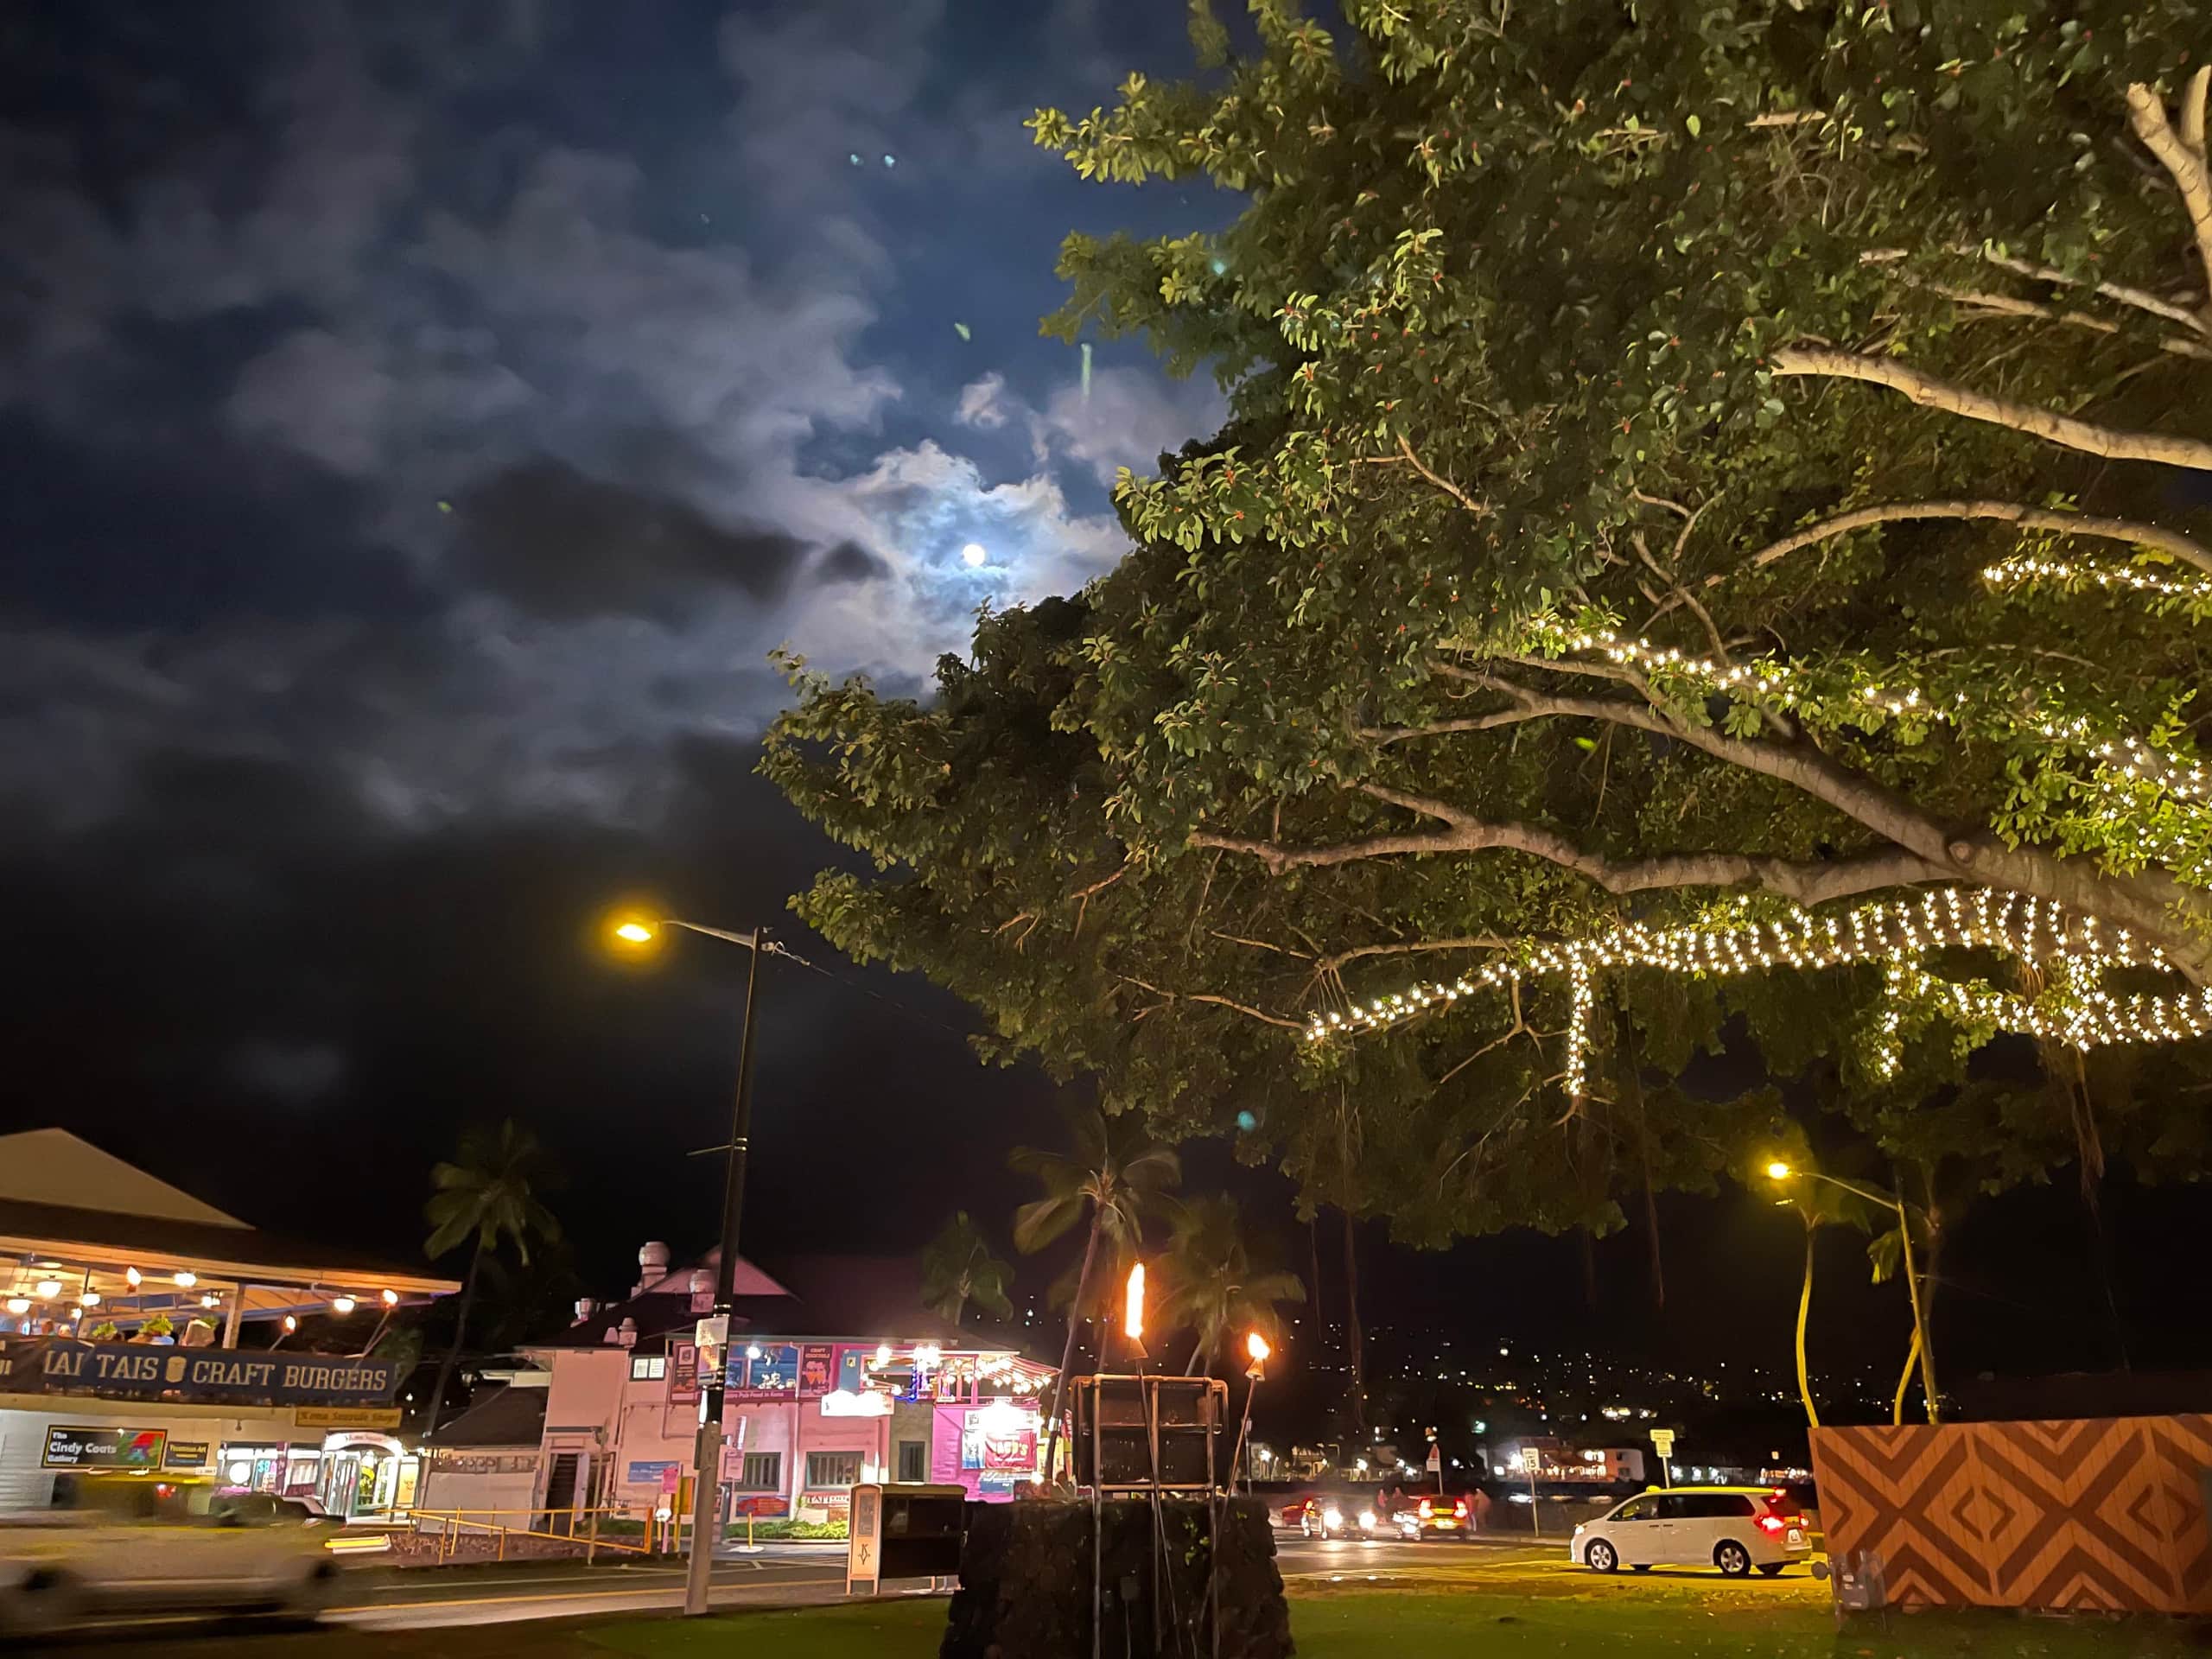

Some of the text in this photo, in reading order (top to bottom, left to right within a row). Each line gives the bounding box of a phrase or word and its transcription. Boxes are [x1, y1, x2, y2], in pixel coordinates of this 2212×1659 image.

[96, 1353, 160, 1380] TAIS
[192, 1360, 276, 1386] CRAFT
[283, 1364, 387, 1391] BURGERS
[49, 1442, 118, 1454] Cindy Coats
[1526, 1459, 1536, 1468] 15
